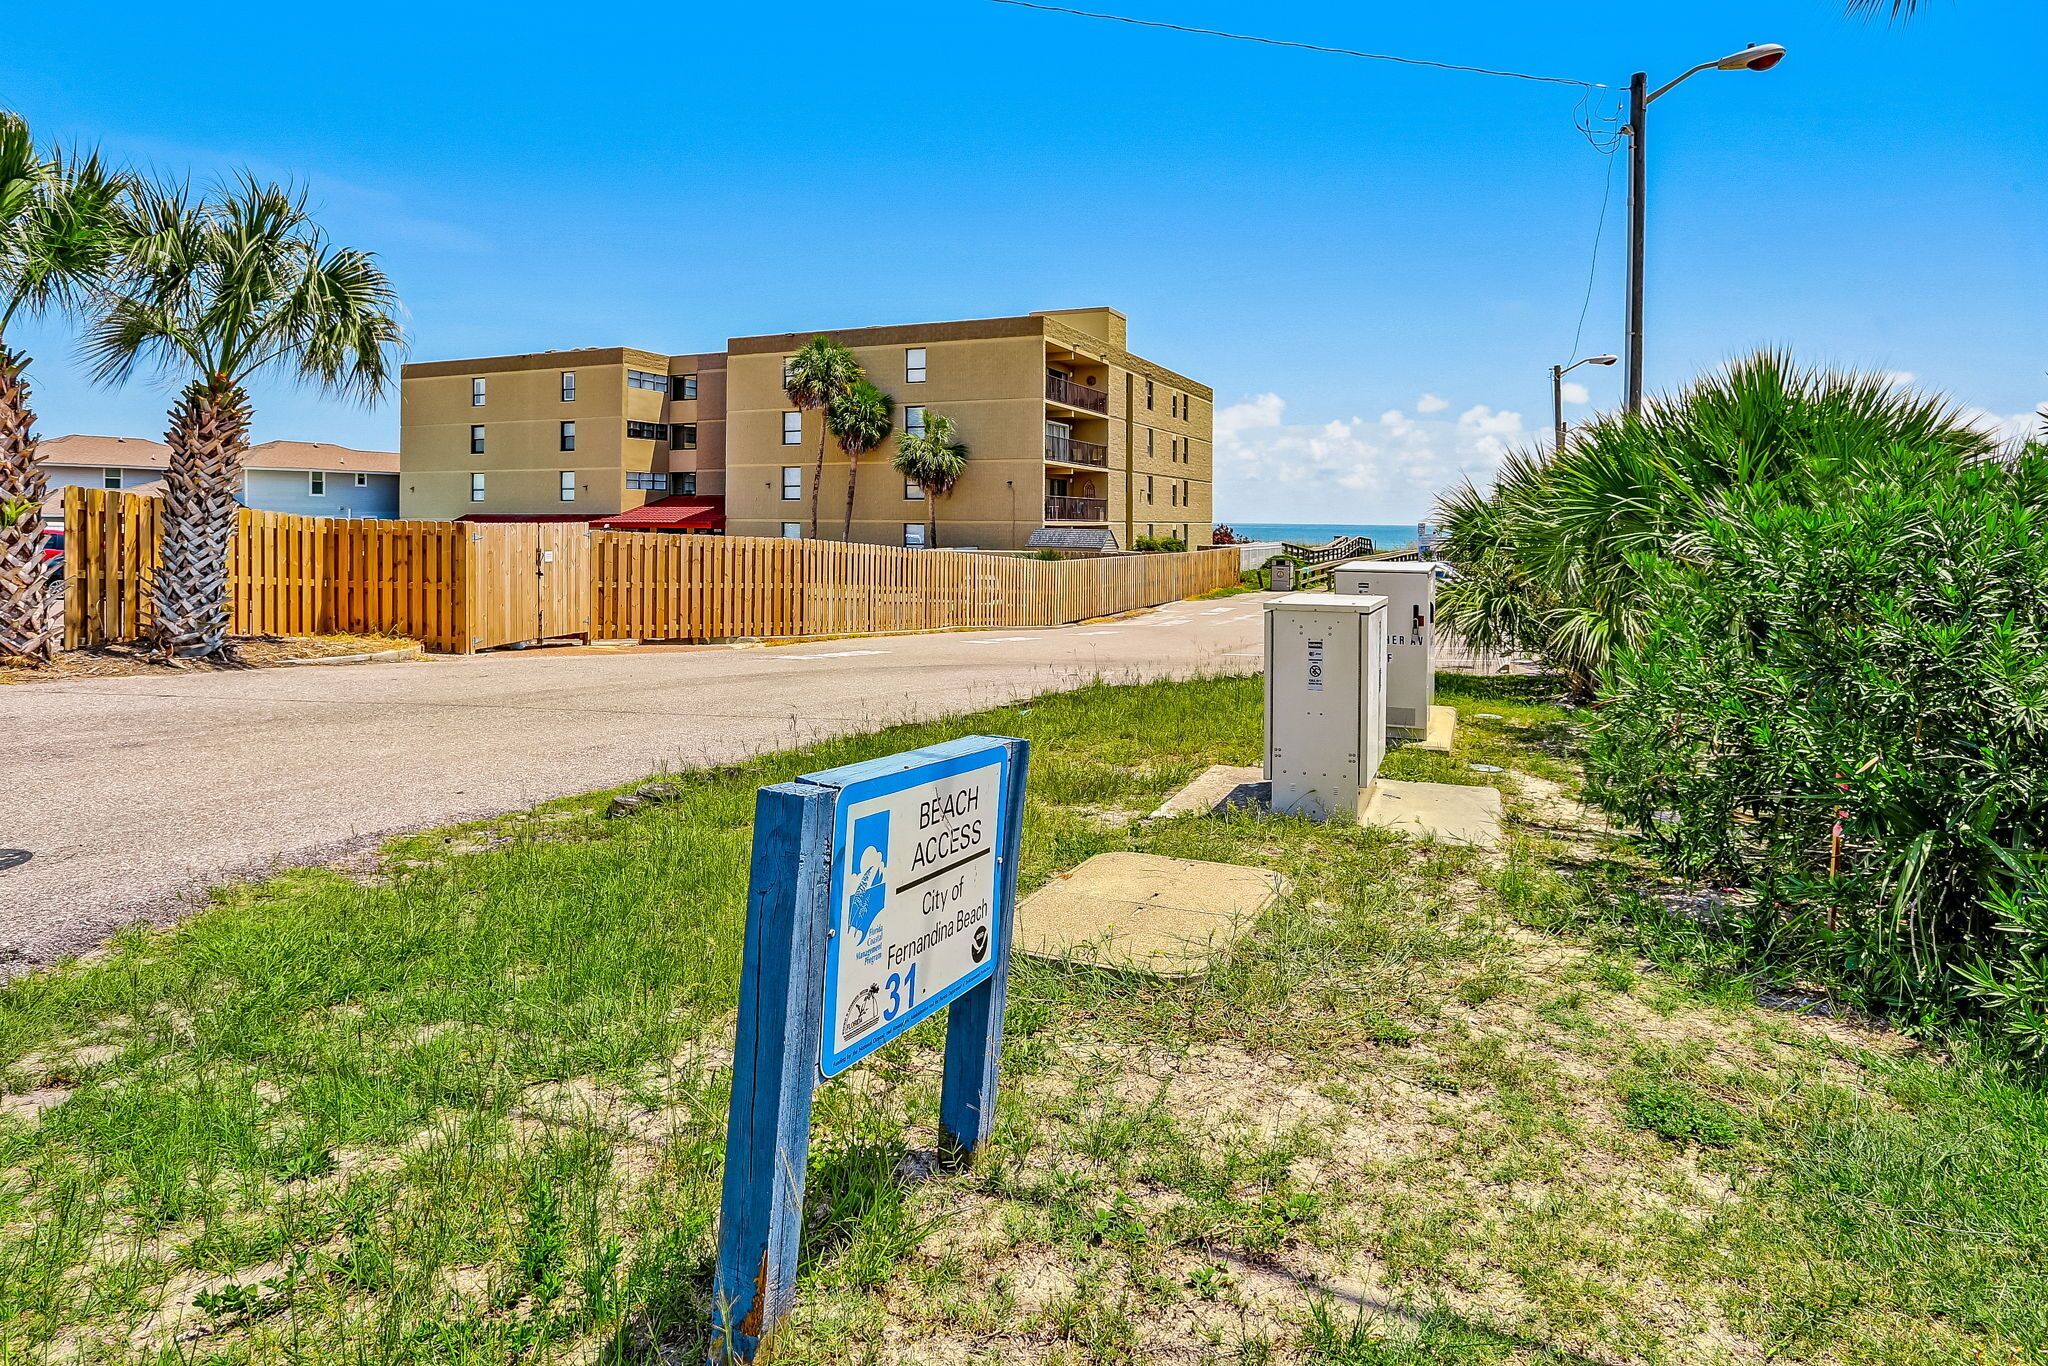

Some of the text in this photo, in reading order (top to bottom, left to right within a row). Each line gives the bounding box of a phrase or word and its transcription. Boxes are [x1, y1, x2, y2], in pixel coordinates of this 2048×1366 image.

[919, 785, 979, 830] BEACH
[911, 819, 982, 872] ACCESS
[922, 875, 964, 915] City of
[887, 898, 988, 970] Fernandina Beach
[883, 962, 916, 1021] 31
